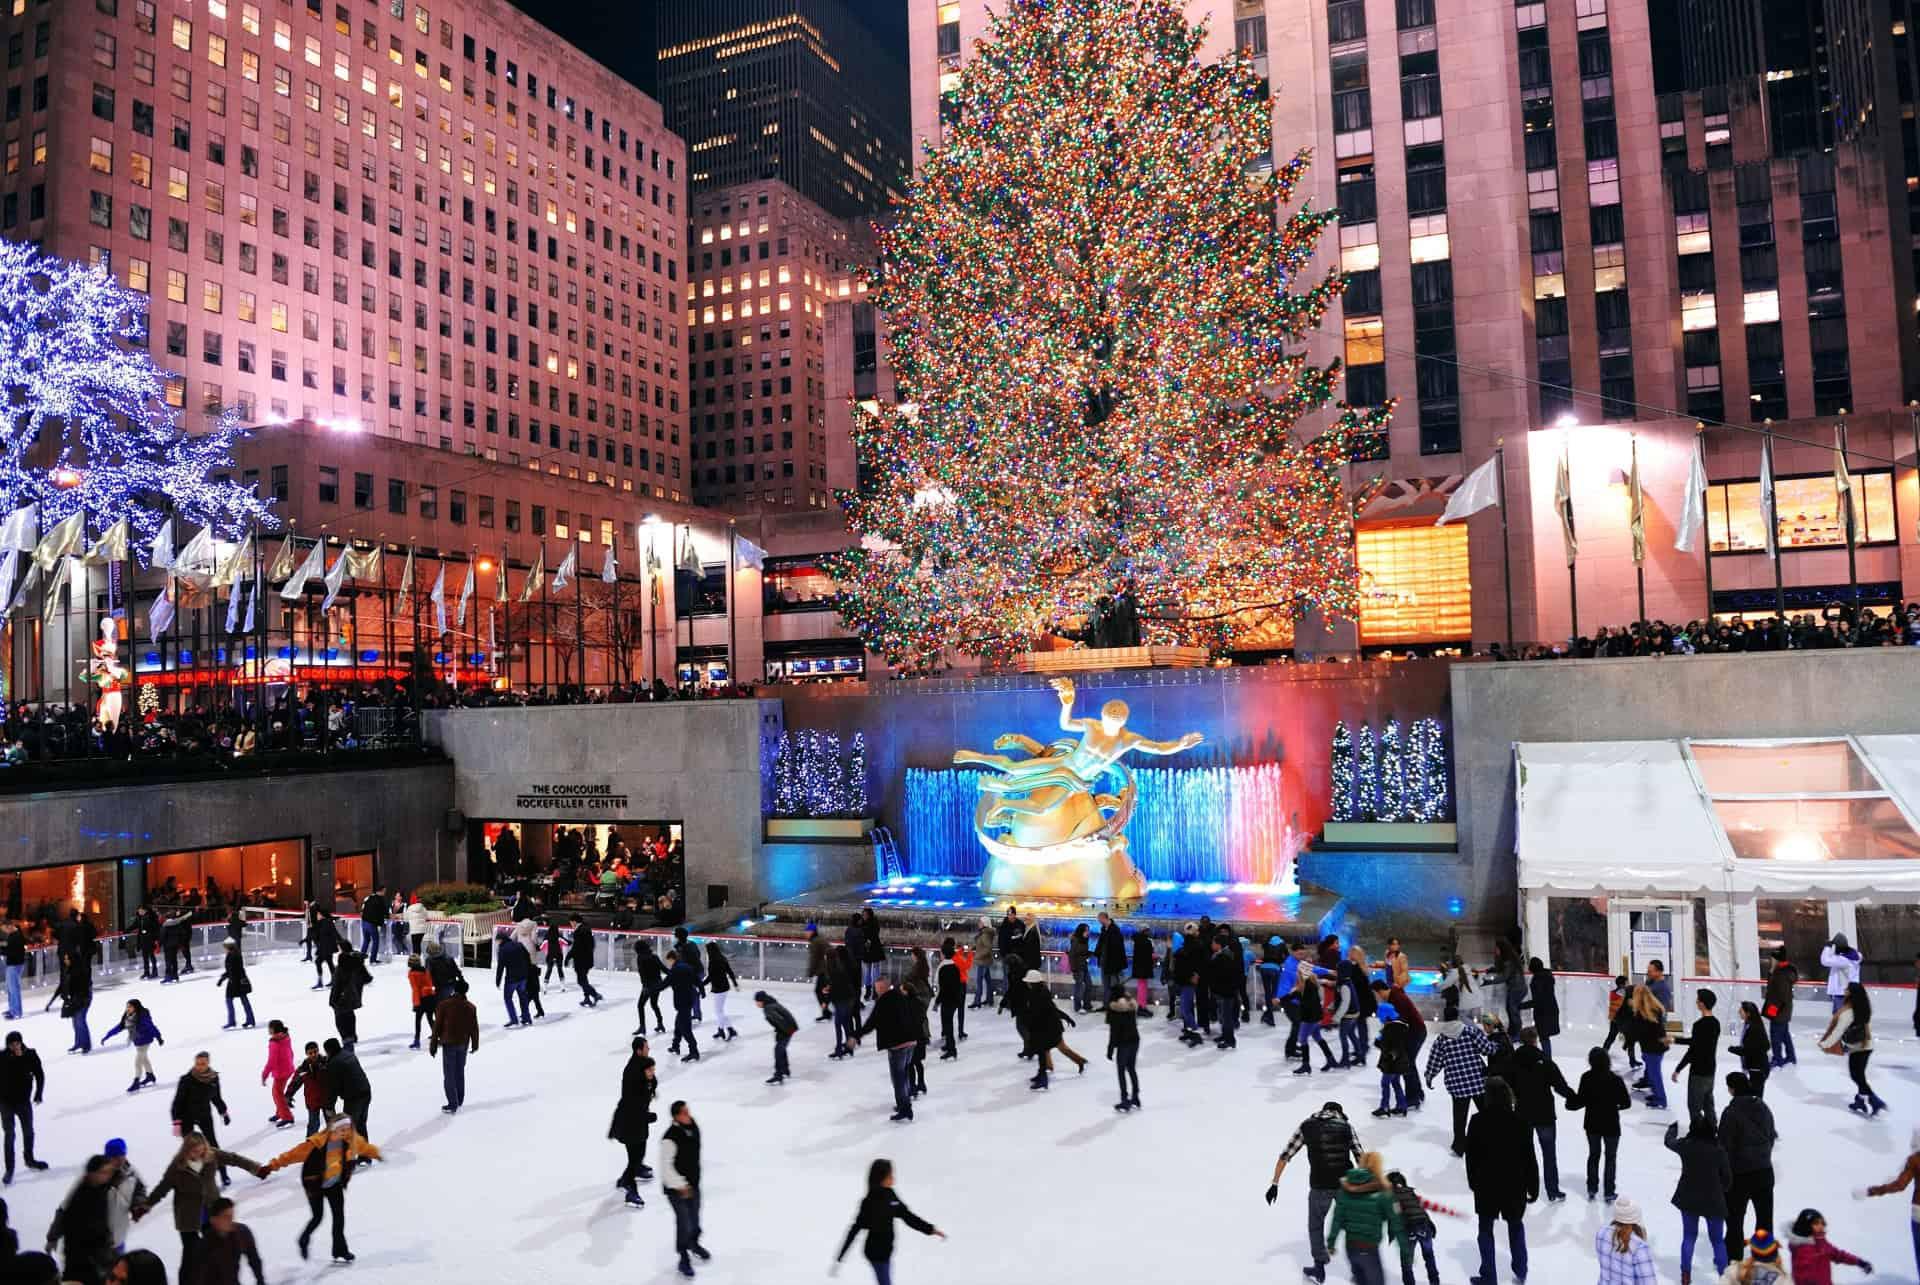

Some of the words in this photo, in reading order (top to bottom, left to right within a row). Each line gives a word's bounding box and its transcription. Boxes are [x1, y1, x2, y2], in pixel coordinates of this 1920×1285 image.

[532, 784, 550, 794] THE
[552, 784, 611, 794] CONCOURSE
[516, 799, 584, 809] ROCKEFELLER
[588, 799, 628, 809] CENTER
